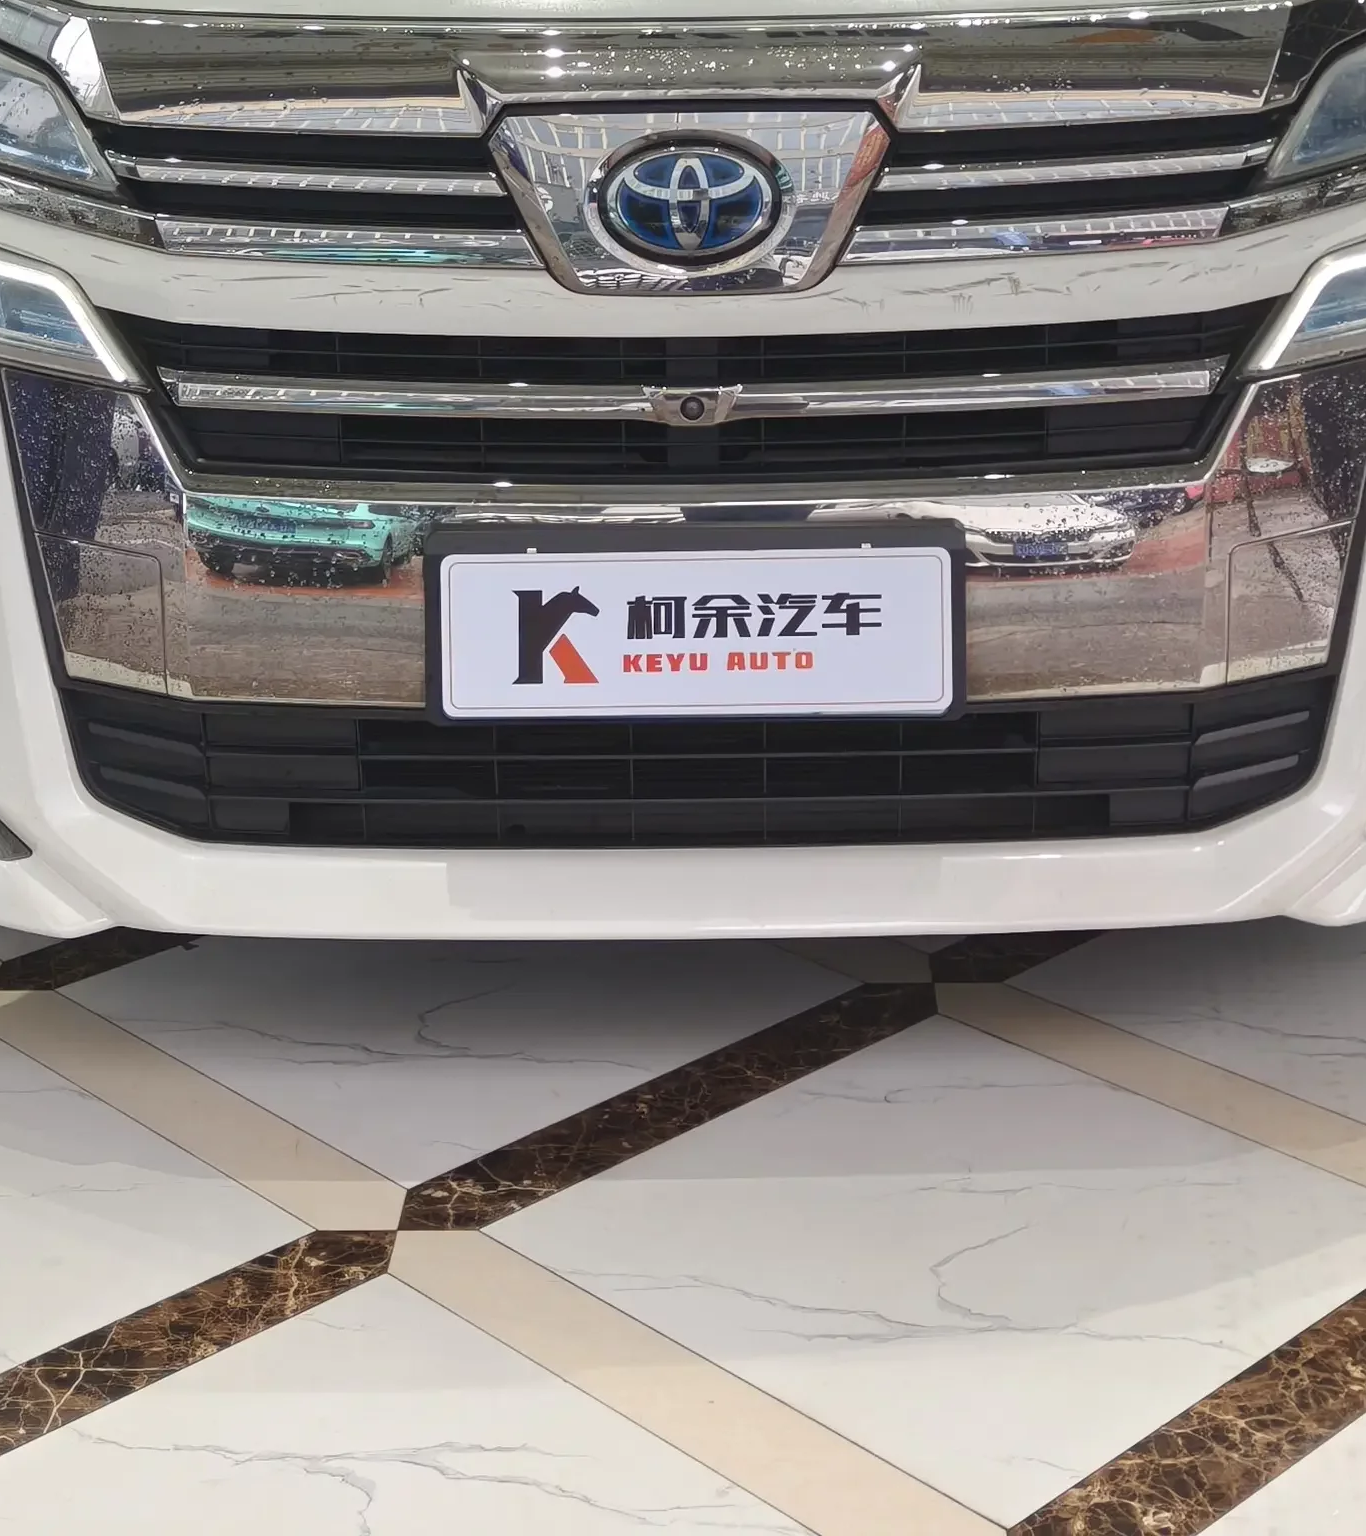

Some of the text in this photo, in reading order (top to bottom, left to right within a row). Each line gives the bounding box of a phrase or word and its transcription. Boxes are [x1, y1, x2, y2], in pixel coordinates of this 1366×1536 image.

[627, 592, 883, 640] 柯余汽车
[623, 650, 814, 673] KEYU AUTO
